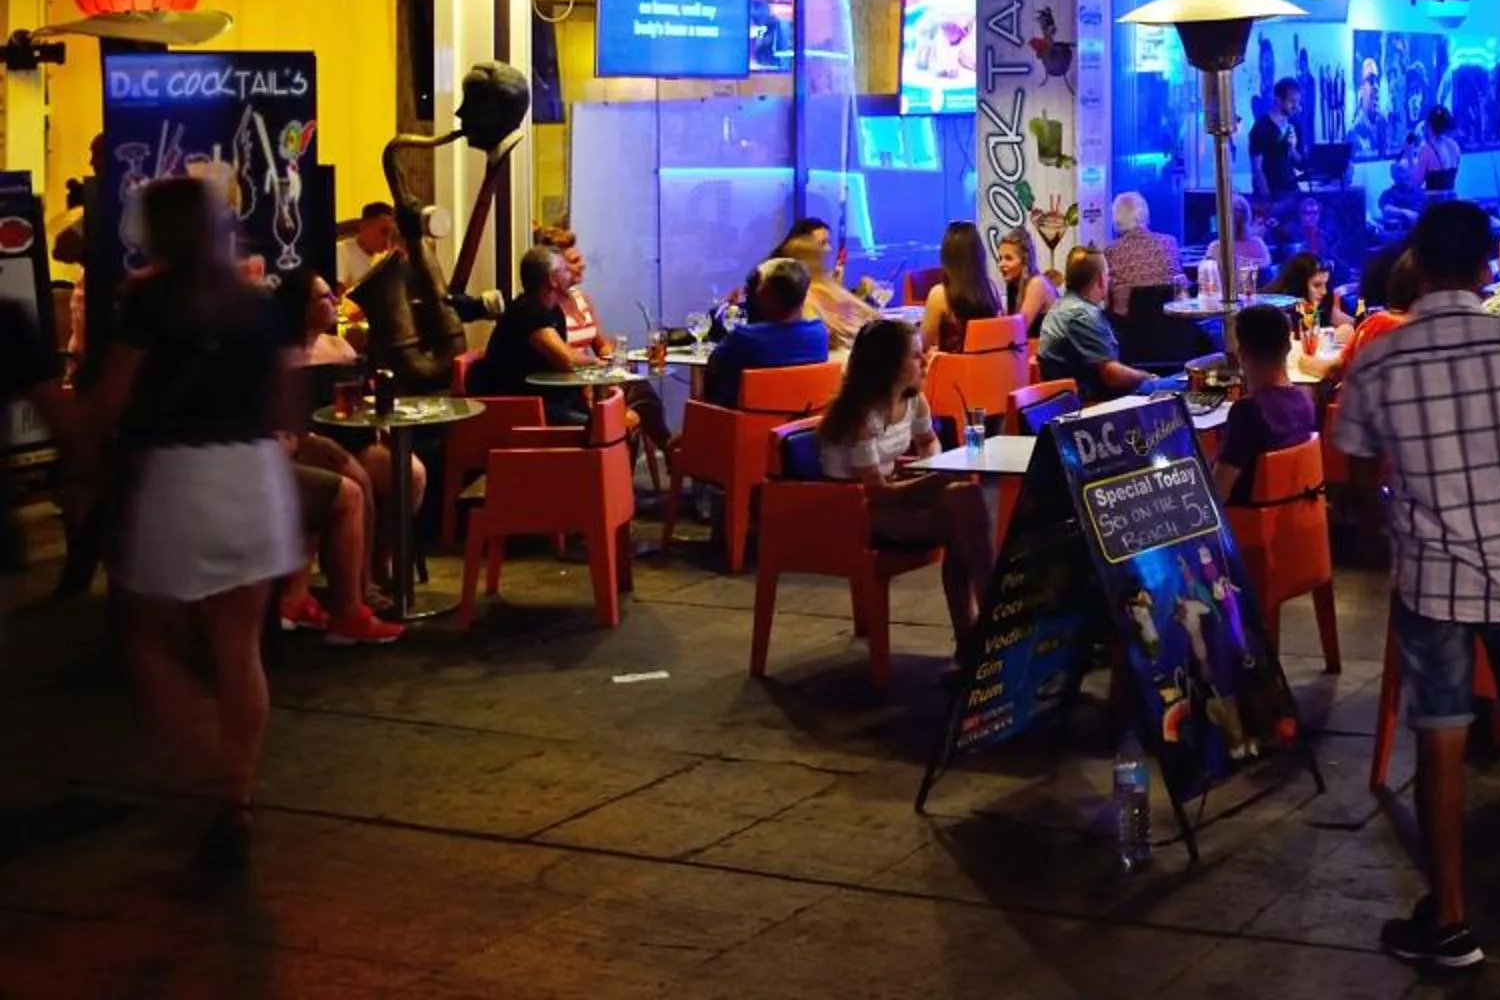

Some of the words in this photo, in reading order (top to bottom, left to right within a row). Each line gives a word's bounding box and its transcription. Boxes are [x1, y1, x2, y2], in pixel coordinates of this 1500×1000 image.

[166, 64, 310, 101] COCKTAIL'S
[1073, 421, 1123, 465] D&C
[1095, 475, 1152, 509] Special
[1154, 466, 1196, 490] Today
